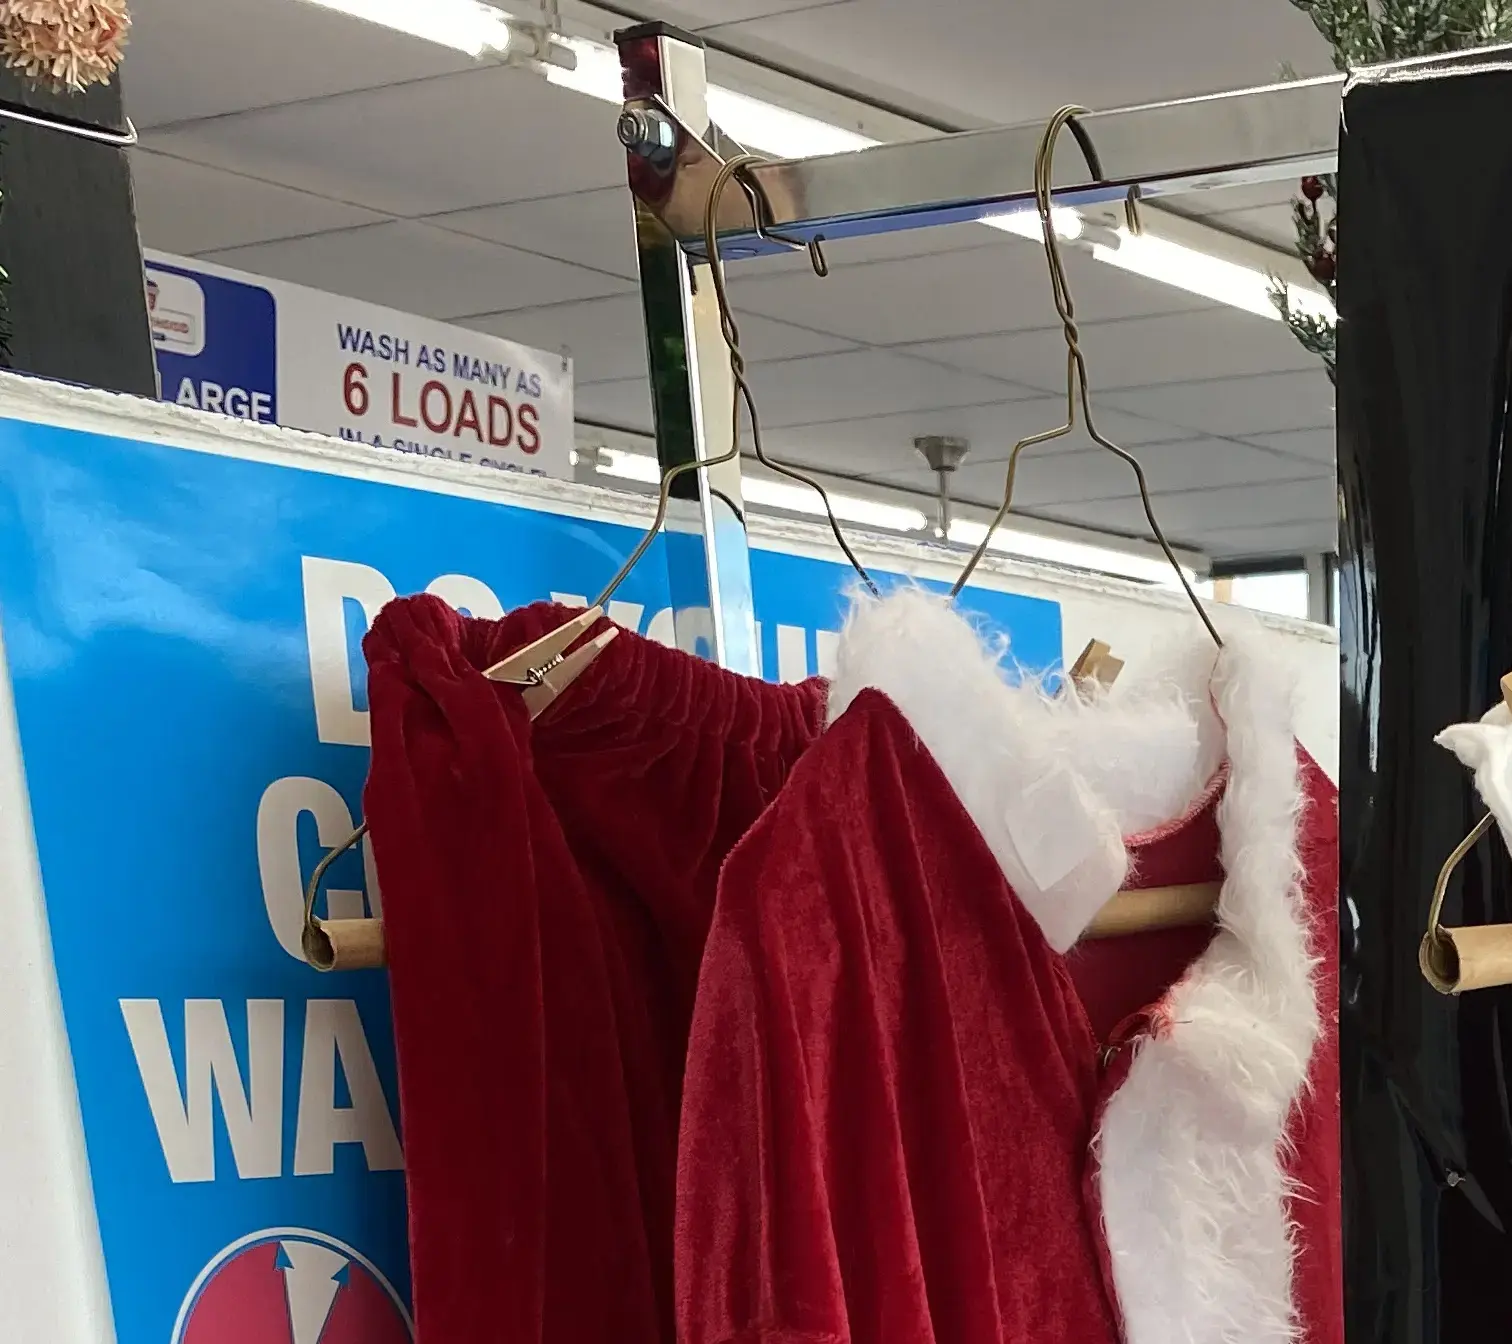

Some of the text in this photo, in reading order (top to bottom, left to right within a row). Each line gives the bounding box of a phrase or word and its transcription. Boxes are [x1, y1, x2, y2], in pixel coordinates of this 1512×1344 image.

[337, 323, 541, 398] WASH AS MANY AS
[343, 362, 541, 454] 6 LOADS
[119, 998, 406, 1183] WA
